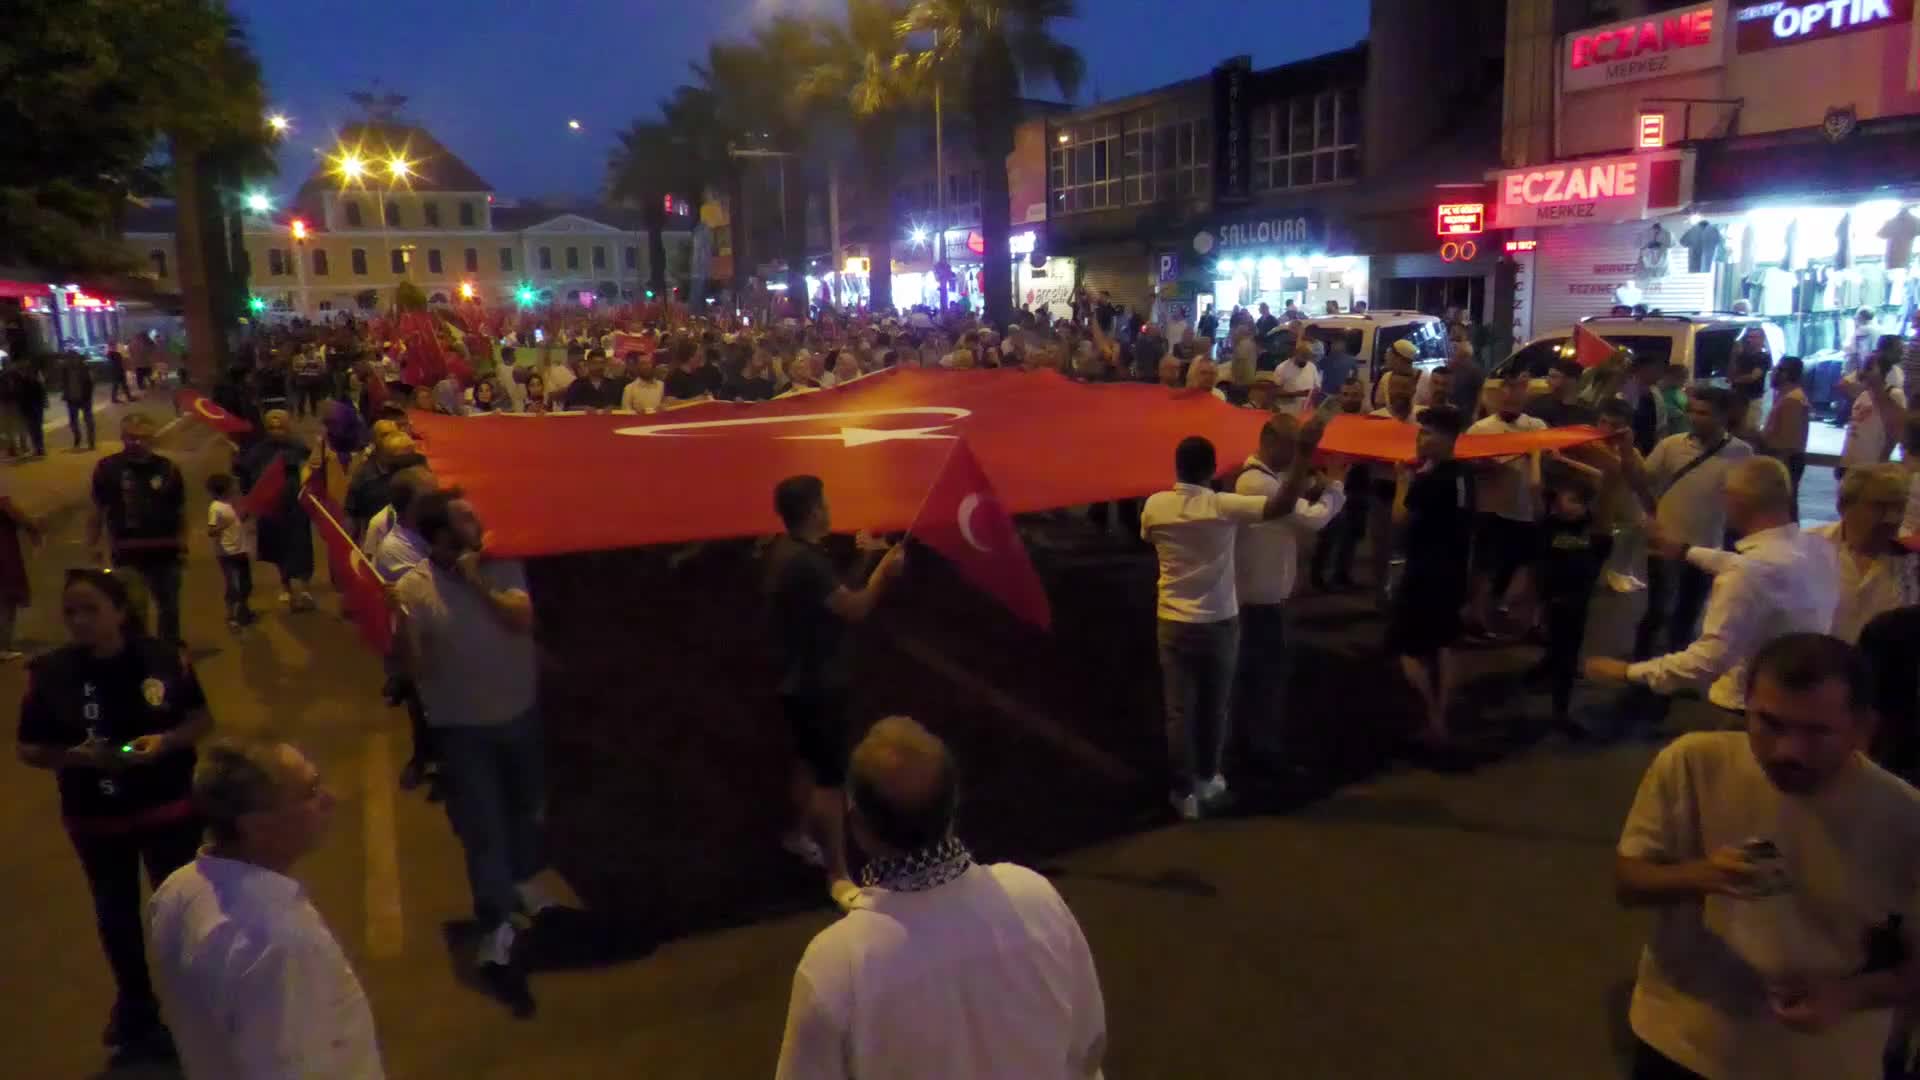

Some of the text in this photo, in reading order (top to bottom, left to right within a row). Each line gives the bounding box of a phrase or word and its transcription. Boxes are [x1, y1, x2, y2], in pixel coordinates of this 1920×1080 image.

[1572, 8, 1713, 69] ECZANE
[1606, 55, 1669, 80] MERKEZ
[1505, 162, 1637, 205] ECZANE
[1537, 203, 1595, 219] MERKEZ
[1219, 217, 1306, 245] SALLOURA
[1160, 256, 1171, 280] P
